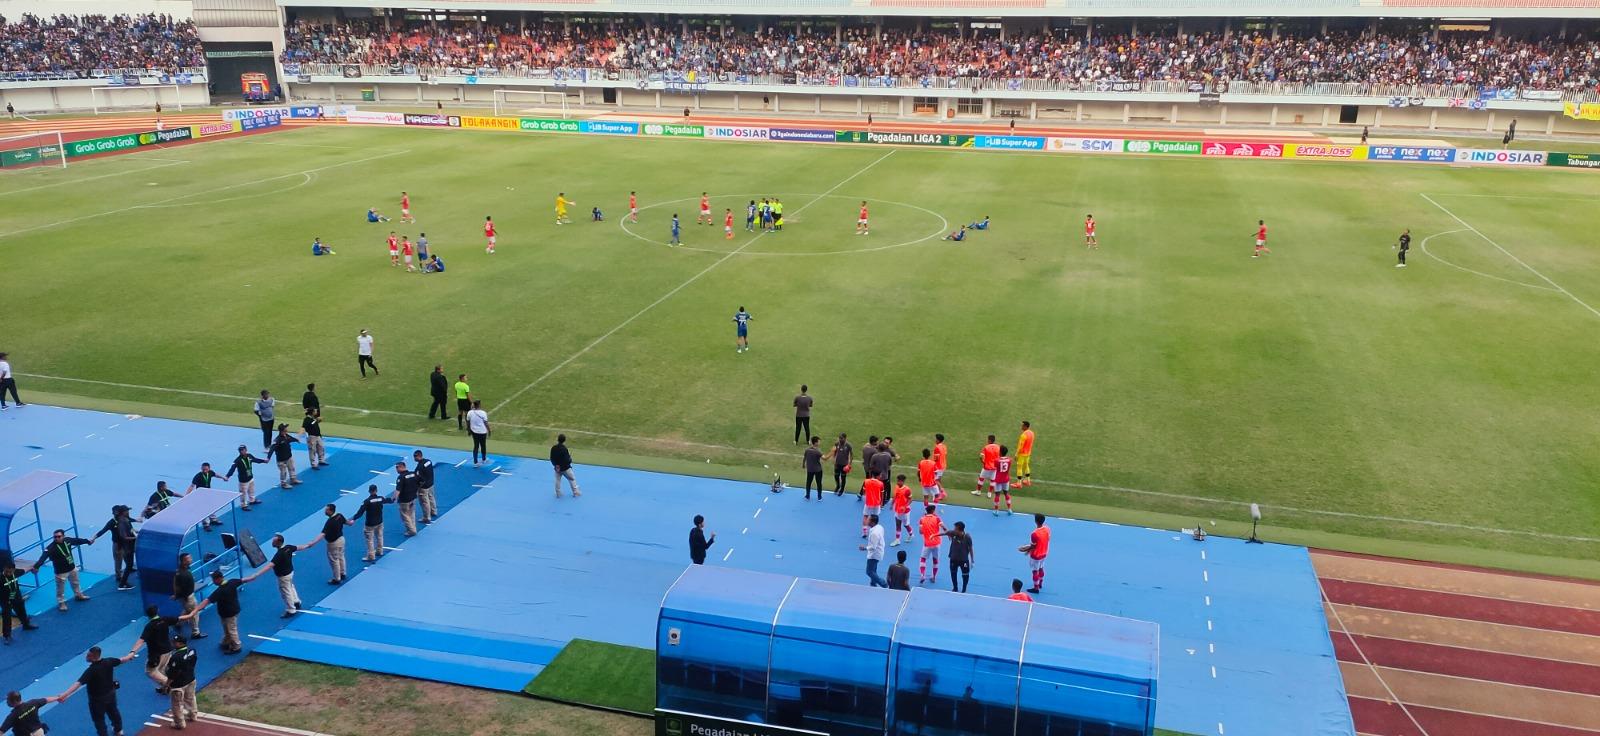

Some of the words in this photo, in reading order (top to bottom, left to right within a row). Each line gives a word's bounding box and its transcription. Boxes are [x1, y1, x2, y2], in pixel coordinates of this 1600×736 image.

[235, 109, 288, 119] INDOSIAR
[521, 121, 539, 129] Grab
[541, 121, 558, 130] Grab
[560, 122, 578, 130] Grab
[665, 126, 702, 135] Pegadaian
[158, 129, 189, 140] Pegadaian
[716, 128, 767, 138] INDOSIAR
[868, 132, 912, 144] Pegadaian
[914, 134, 934, 143] LIGA
[935, 135, 942, 143] 2
[75, 142, 95, 153] Grab
[96, 140, 115, 150] Grab
[117, 137, 135, 147] Grab
[1023, 140, 1037, 148] App
[1081, 140, 1113, 150] SCM
[1153, 143, 1198, 152] Pegadaian
[1296, 147, 1327, 156] EXTRA
[1328, 148, 1352, 156] JOSS
[1471, 152, 1543, 163] INDOSIAR
[1000, 462, 1008, 472] 13
